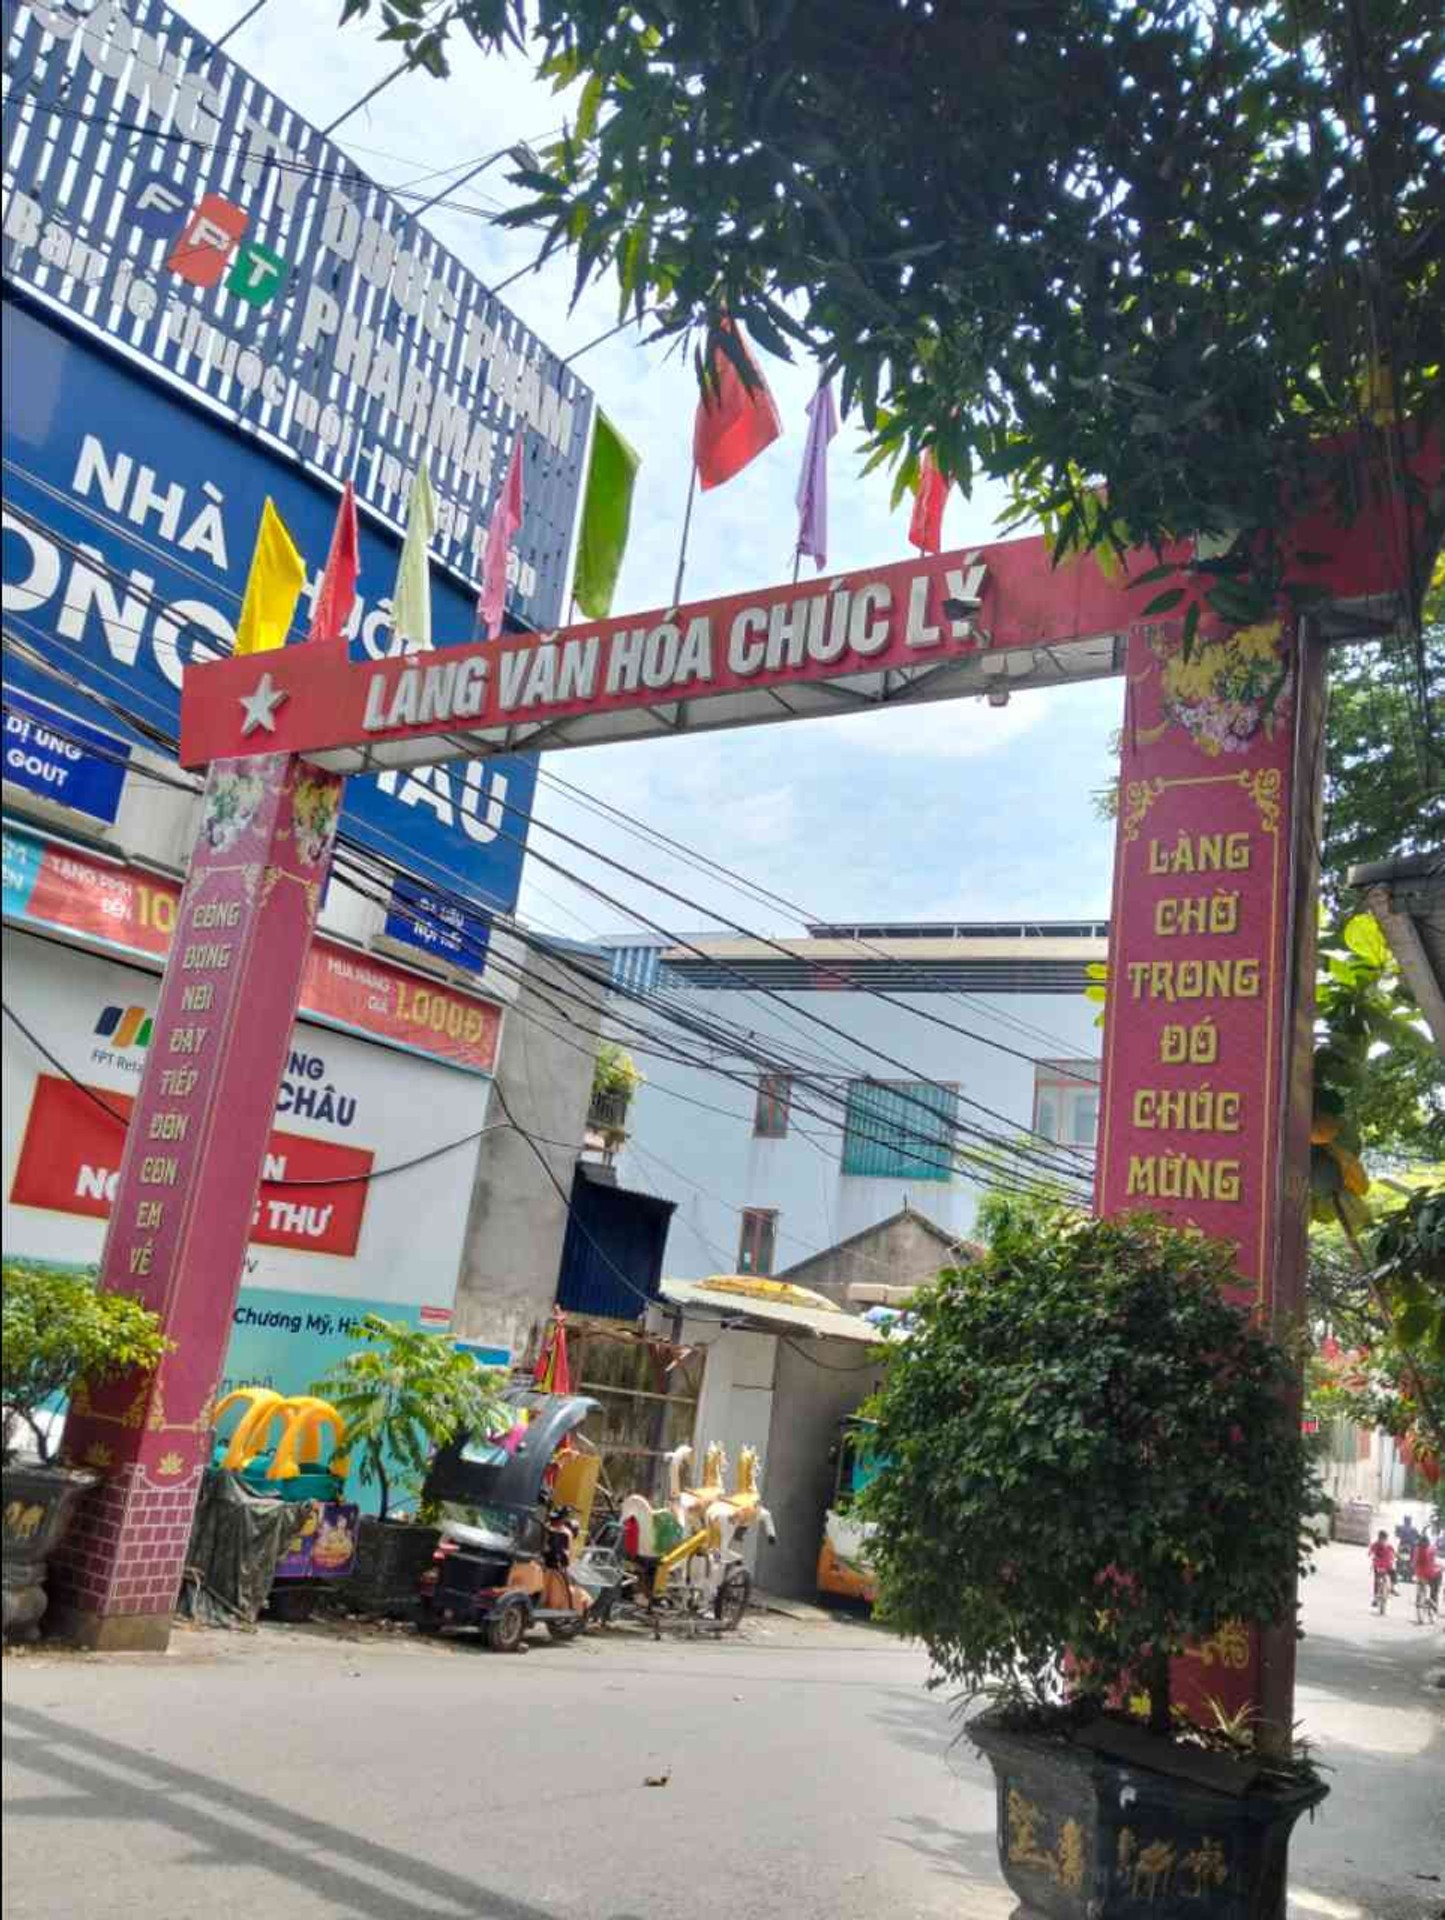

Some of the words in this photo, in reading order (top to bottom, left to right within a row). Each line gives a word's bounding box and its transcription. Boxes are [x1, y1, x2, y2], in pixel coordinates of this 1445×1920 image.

[136, 181, 279, 288] FPT
[299, 283, 493, 489] PHARMA
[72, 433, 228, 570] NHÀ
[363, 655, 488, 731] LÀNG
[499, 633, 600, 711] VĂN
[605, 607, 713, 694] HÓA
[727, 577, 893, 677] CHÚC
[904, 550, 988, 648] LÝ
[7, 748, 69, 787] GOUT
[1147, 829, 1250, 875] LÀNG
[1155, 889, 1239, 936] CHỜ
[1127, 958, 1260, 1003] TRONG
[91, 1048, 115, 1066] FPT
[1160, 1019, 1219, 1065] ĐÓ
[275, 1081, 357, 1127] CHÂU
[1132, 1082, 1241, 1132] CHÚC
[140, 1156, 179, 1186] CON
[1126, 1149, 1241, 1202] MỪNG
[136, 1200, 164, 1228] EM
[267, 1199, 333, 1238] THƯ
[233, 1306, 301, 1334] Chương
